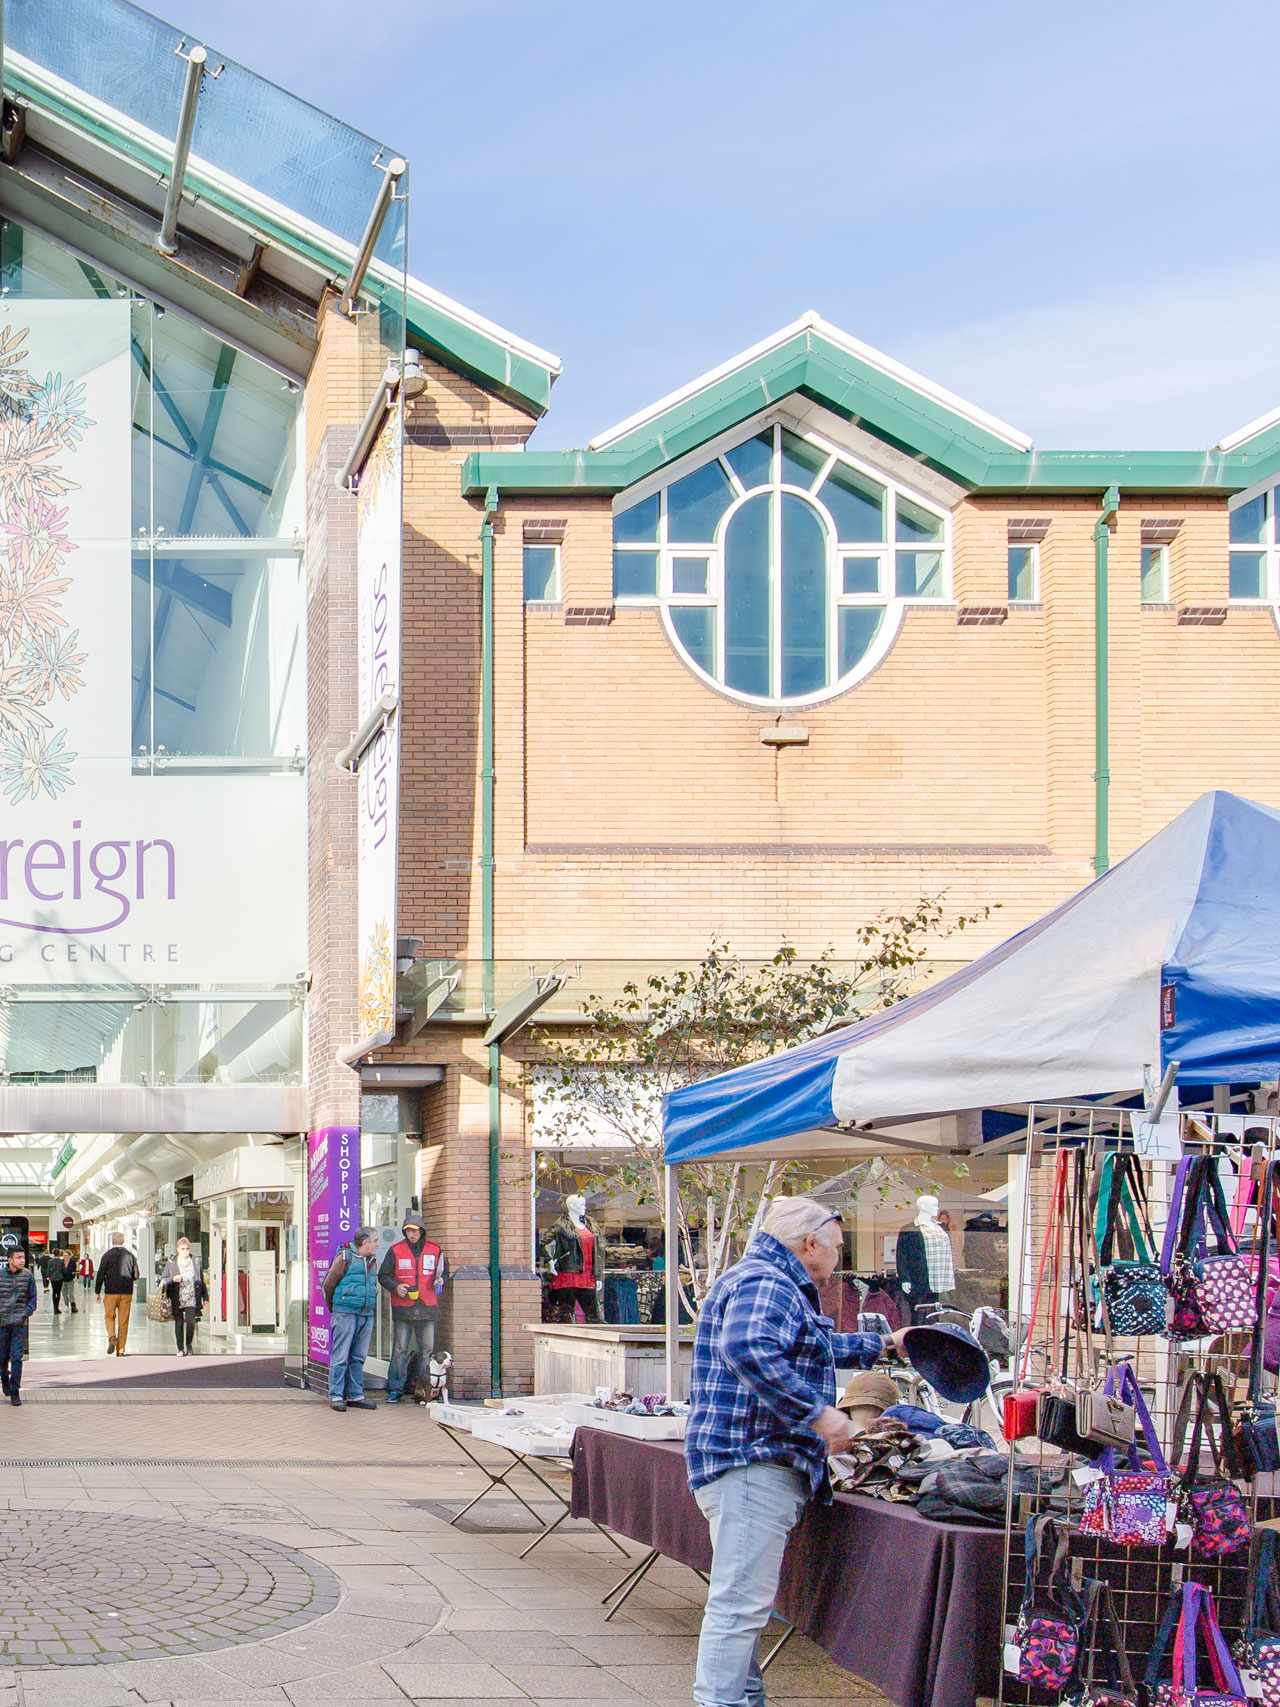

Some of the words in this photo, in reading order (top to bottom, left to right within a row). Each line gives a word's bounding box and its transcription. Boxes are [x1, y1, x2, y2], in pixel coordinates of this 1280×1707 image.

[367, 562, 392, 850] soveeign
[41, 944, 179, 963] CENTRE
[339, 1133, 351, 1232] SHOPPING
